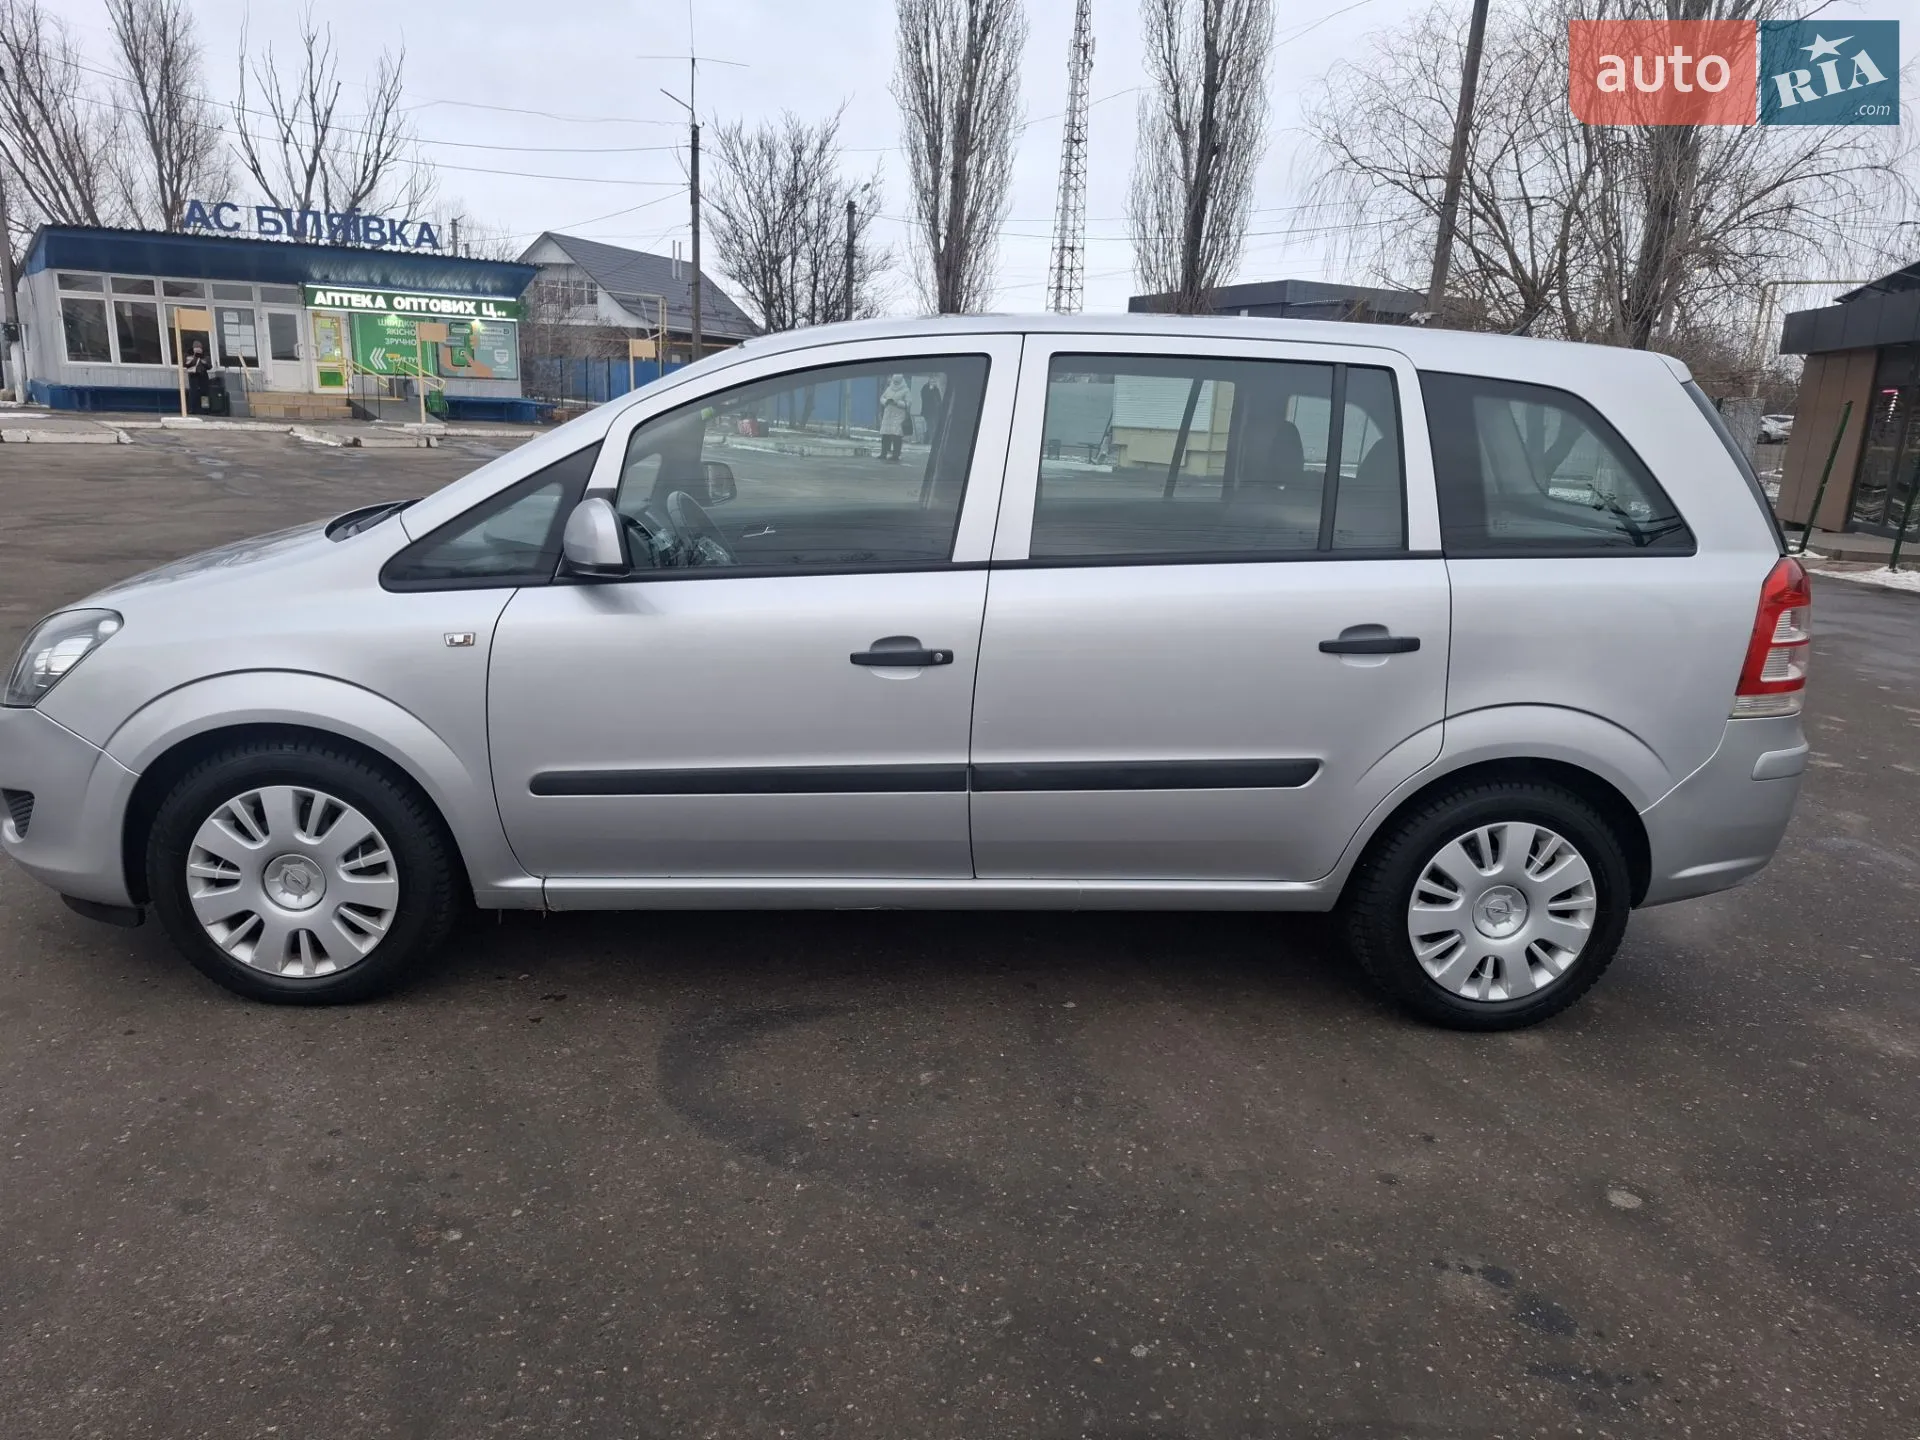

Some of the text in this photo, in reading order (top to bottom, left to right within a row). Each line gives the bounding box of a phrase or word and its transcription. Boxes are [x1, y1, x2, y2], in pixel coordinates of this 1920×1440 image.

[183, 199, 440, 250] АС БІЛЯЇВКА
[314, 291, 387, 309] АПТЕКА
[393, 296, 477, 315] ОПТОВИХ
[385, 337, 417, 346] ЗРУЧНО
